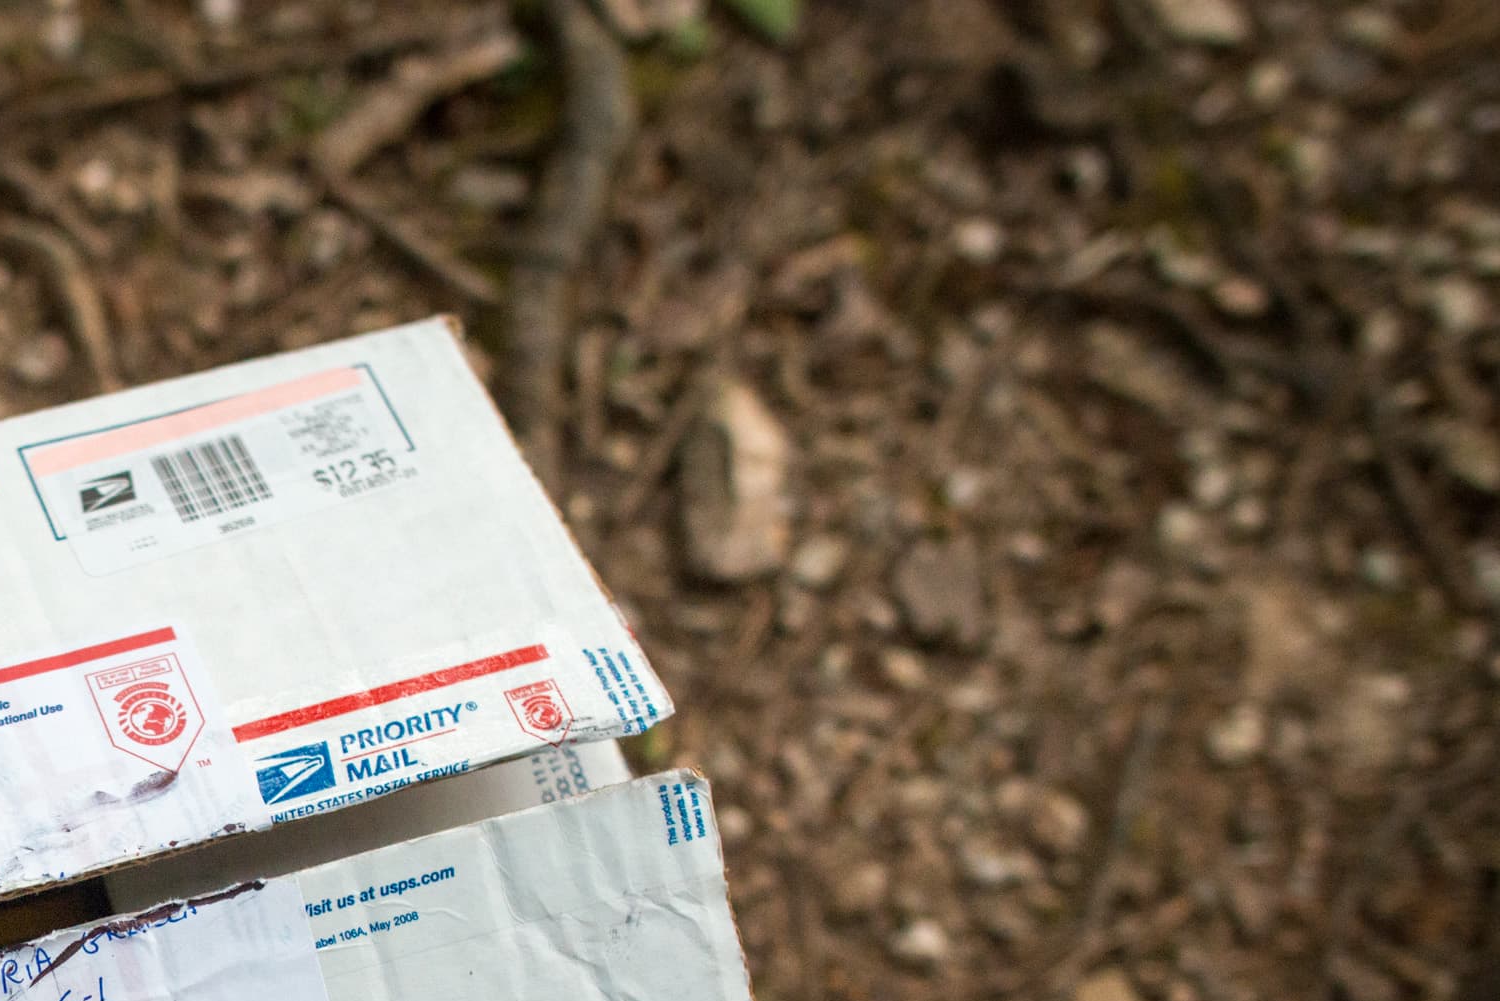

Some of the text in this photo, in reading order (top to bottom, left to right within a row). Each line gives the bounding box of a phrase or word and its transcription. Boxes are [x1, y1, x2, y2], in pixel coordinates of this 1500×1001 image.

[40, 703, 63, 718] Use
[347, 749, 418, 783] MAIL
[317, 793, 363, 814] STATES
[366, 777, 413, 801] POSTAL
[416, 760, 469, 784] SERVICE
[337, 895, 355, 911] us
[360, 885, 376, 902] at
[379, 865, 456, 900] usps.com
[314, 910, 419, 949] abel 106A, May 2008
